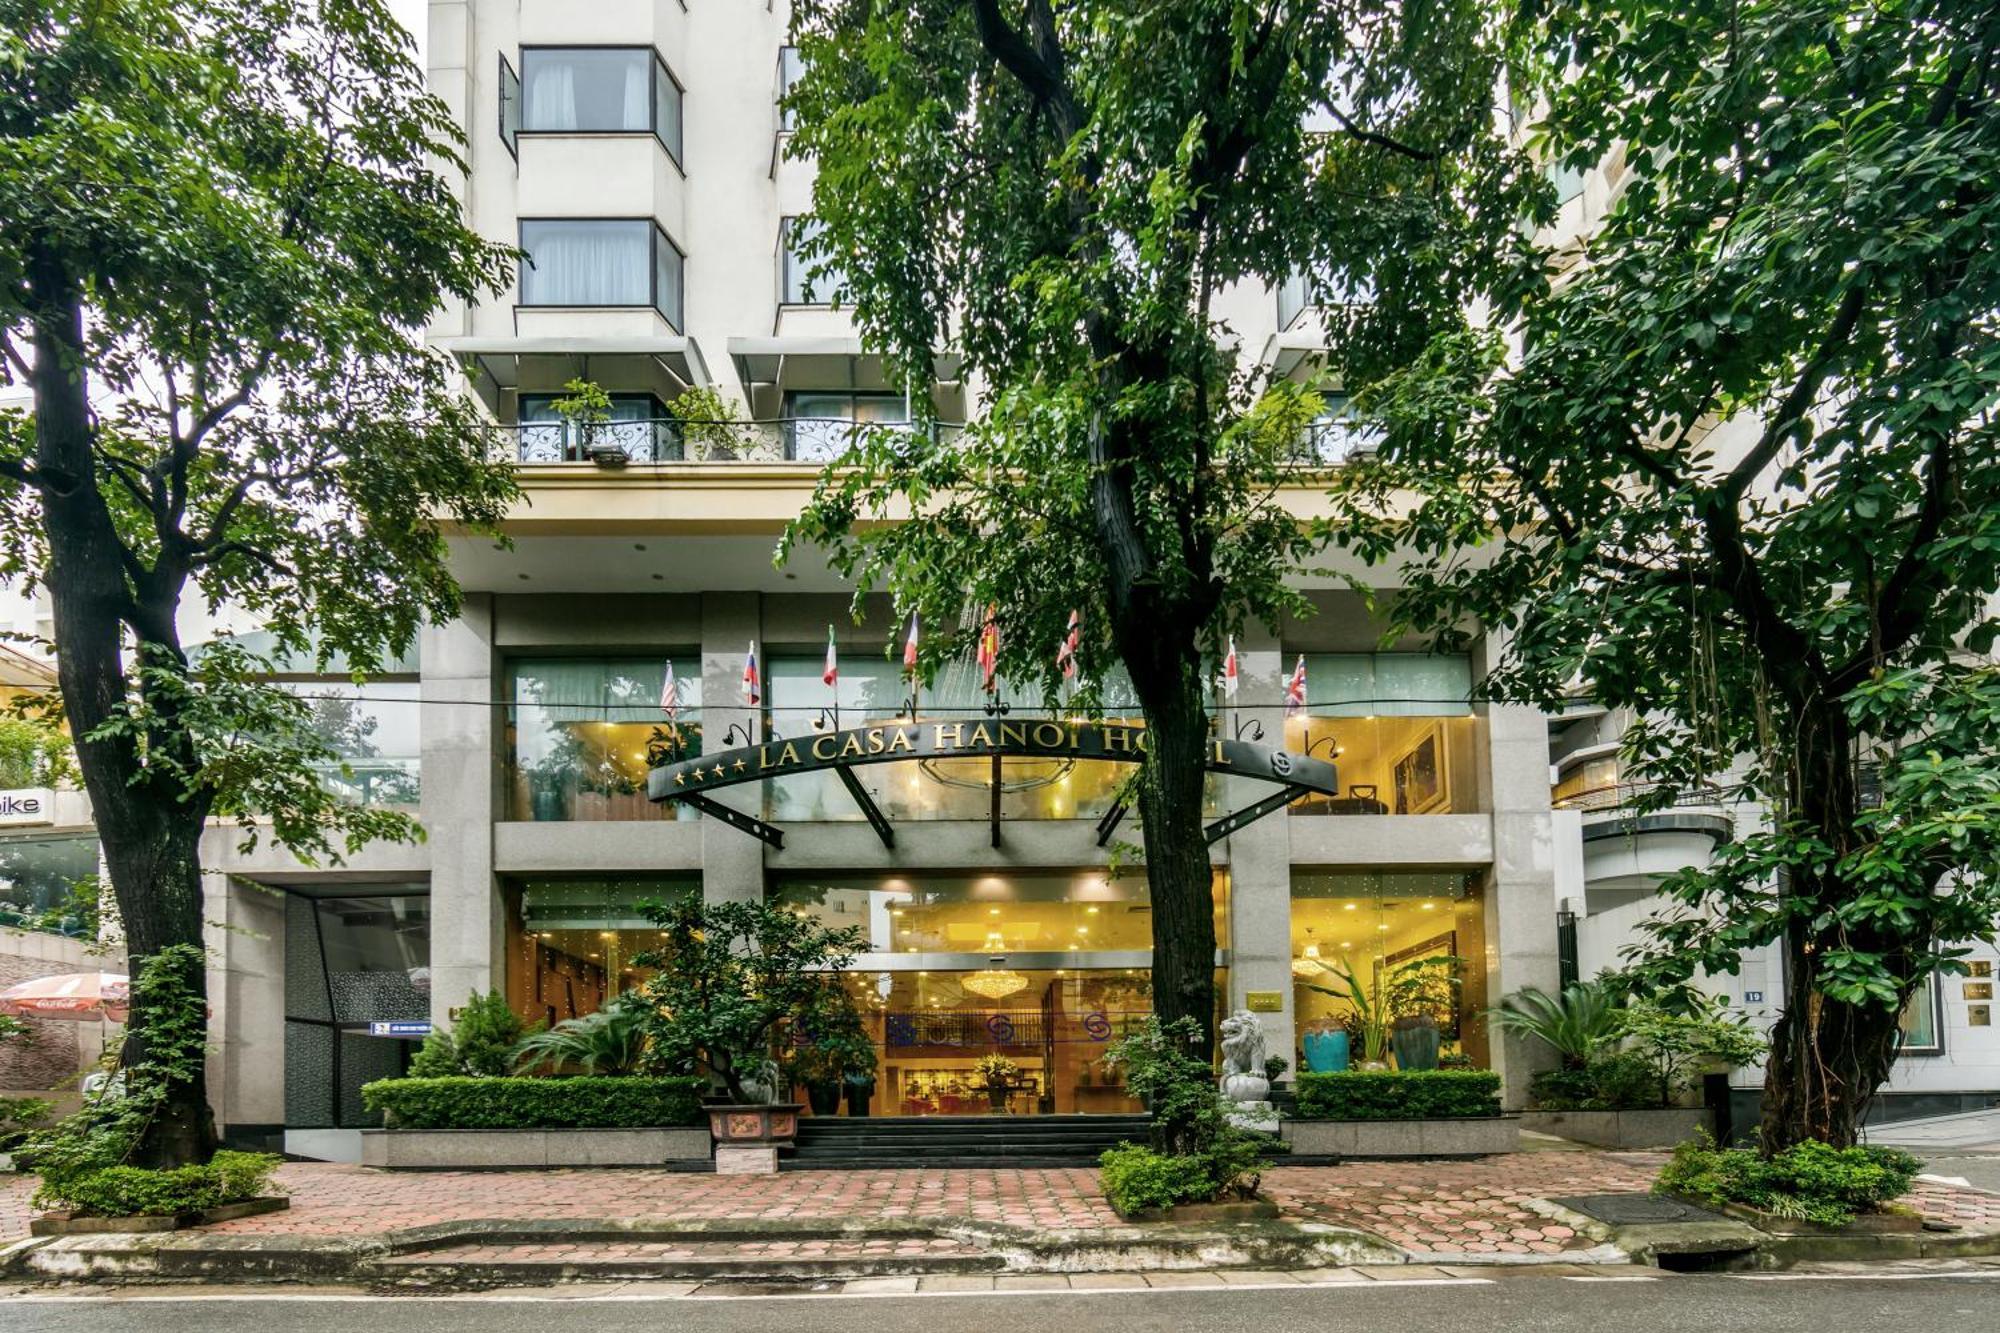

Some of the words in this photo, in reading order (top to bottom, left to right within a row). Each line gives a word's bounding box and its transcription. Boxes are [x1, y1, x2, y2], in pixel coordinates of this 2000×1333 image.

[760, 741, 801, 769] LA
[812, 727, 914, 760] CASA
[934, 722, 1080, 749] HANOI
[0, 796, 39, 813] ike
[1748, 992, 1761, 1001] 19
